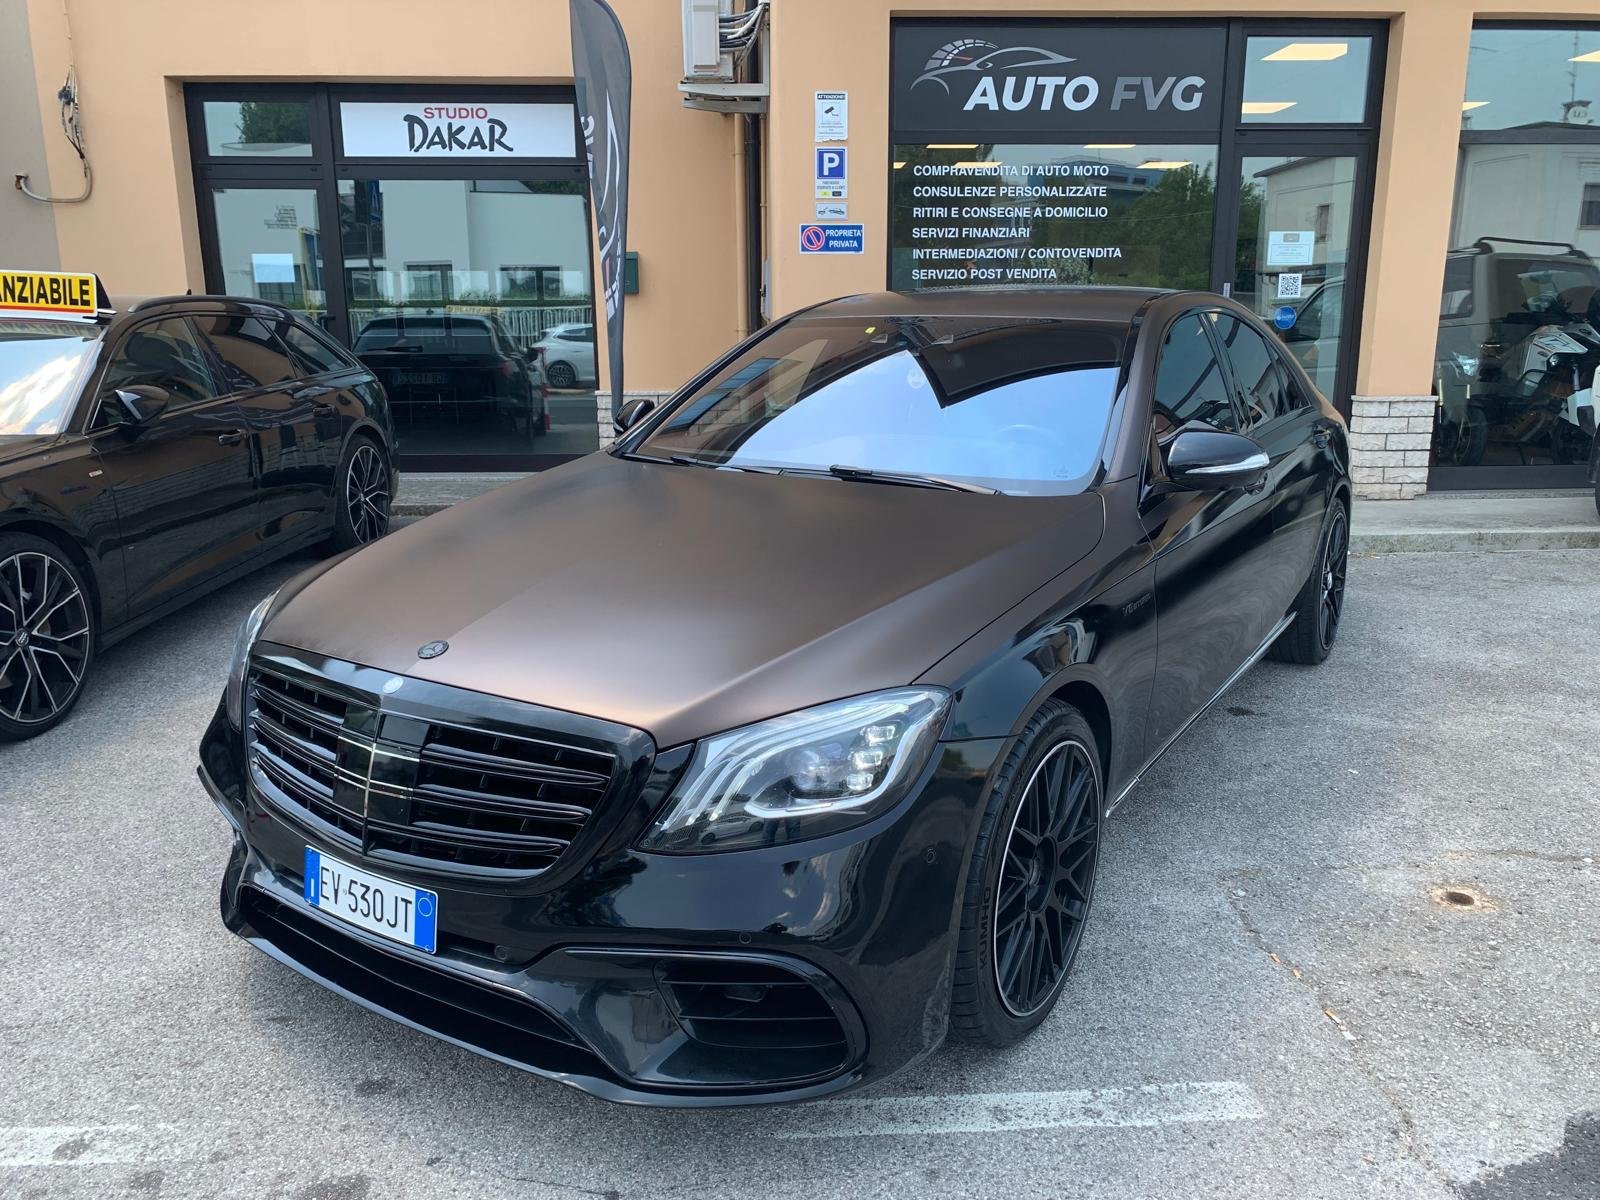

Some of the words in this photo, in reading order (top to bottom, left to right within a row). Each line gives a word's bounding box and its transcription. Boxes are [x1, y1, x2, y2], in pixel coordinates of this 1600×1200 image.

[962, 76, 1100, 111] AUTO
[1110, 76, 1206, 111] FVG
[423, 107, 488, 119] STUDIO
[403, 114, 514, 152] DAKAR
[823, 152, 840, 176] P
[913, 165, 1018, 177] COMPRAVENDITA
[1021, 165, 1034, 177] DI
[1036, 165, 1071, 177] AUTO
[1073, 165, 1110, 177] MOTO
[913, 186, 996, 197] CONSULENZE
[999, 186, 1107, 197] PERSONALIZZATE
[913, 207, 948, 218] RITIRI
[951, 207, 959, 218] E
[962, 207, 1031, 218] CONSEGNE
[1033, 207, 1042, 218] A
[1045, 206, 1108, 218] DOMICILIO
[912, 227, 959, 238] SERVIZI
[962, 227, 1030, 238] FINANZIARI
[829, 240, 858, 248] PRIVATA
[912, 248, 1018, 259] INTERMEDIAZIONI
[1028, 247, 1122, 259] CONTOVENDITA
[911, 269, 967, 280] SERVIZIO
[970, 268, 1003, 279] POST
[1006, 268, 1057, 279] VENDITA
[0, 275, 91, 306] NZIABILE
[320, 866, 341, 905] EV
[979, 886, 991, 969] KUMHO
